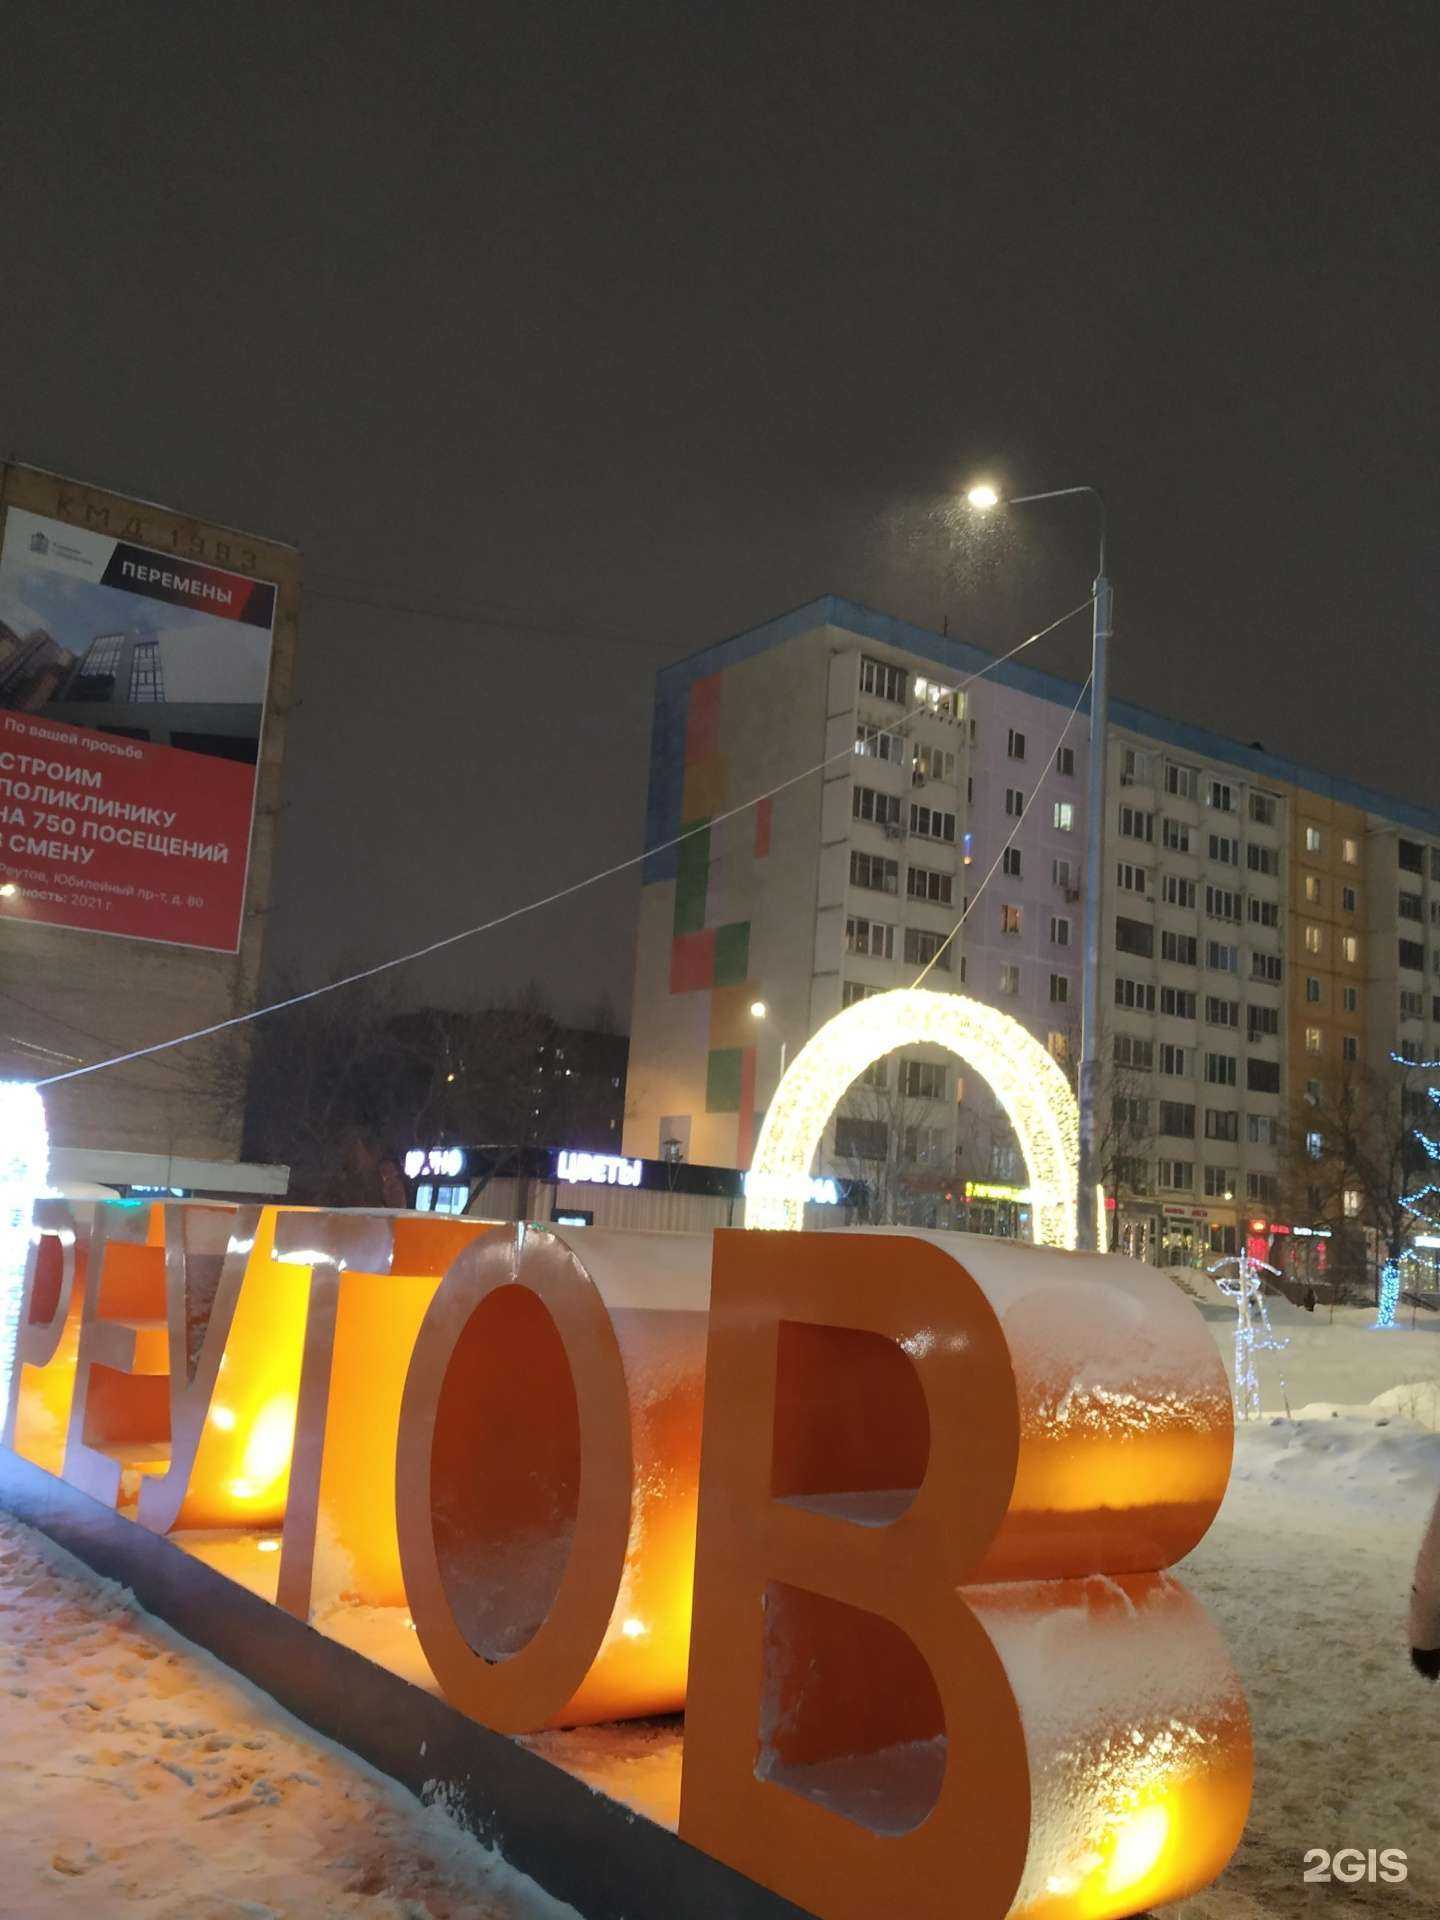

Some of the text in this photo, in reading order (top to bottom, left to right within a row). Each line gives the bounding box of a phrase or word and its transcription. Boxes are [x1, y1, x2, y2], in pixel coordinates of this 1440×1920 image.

[121, 560, 233, 605] ПЕРЕМЕНЫ
[5, 718, 144, 760] По вашей просьбе
[0, 753, 102, 789] СТРОИМ
[0, 778, 176, 827] ПОЛИКЛИНИКУ
[9, 835, 95, 864] СМЕНУ
[33, 812, 76, 835] 750
[82, 821, 229, 864] ПОСЕЩЕНИЙ
[558, 1151, 642, 1187] ЦВЕТЫ
[0, 1198, 1252, 1920] РЕУТОВ
